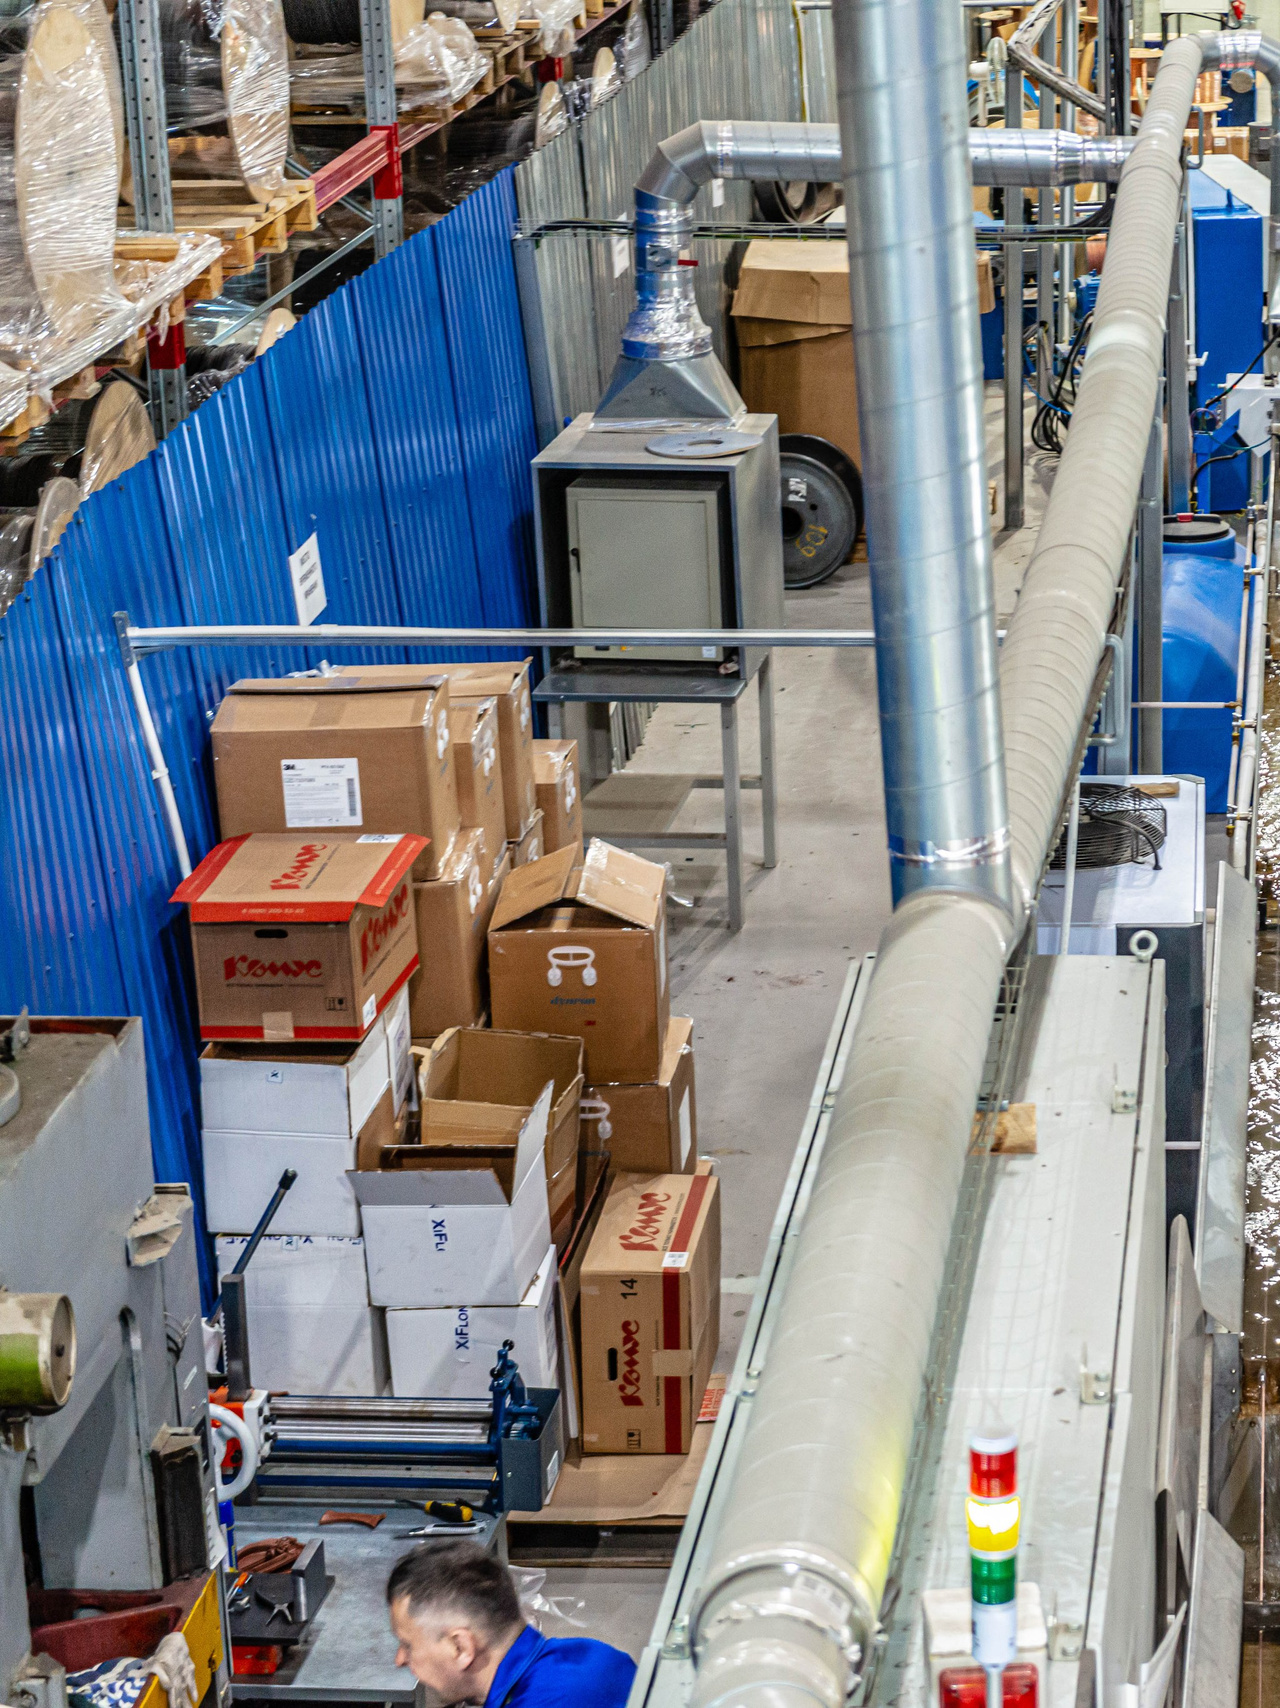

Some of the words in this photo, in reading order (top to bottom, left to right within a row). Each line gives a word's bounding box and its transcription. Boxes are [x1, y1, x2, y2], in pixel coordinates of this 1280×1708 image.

[269, 844, 328, 891] Комус
[223, 954, 323, 981] Комус
[619, 1192, 671, 1252] Комус
[619, 1278, 638, 1299] 14
[617, 1319, 645, 1407] Комус
